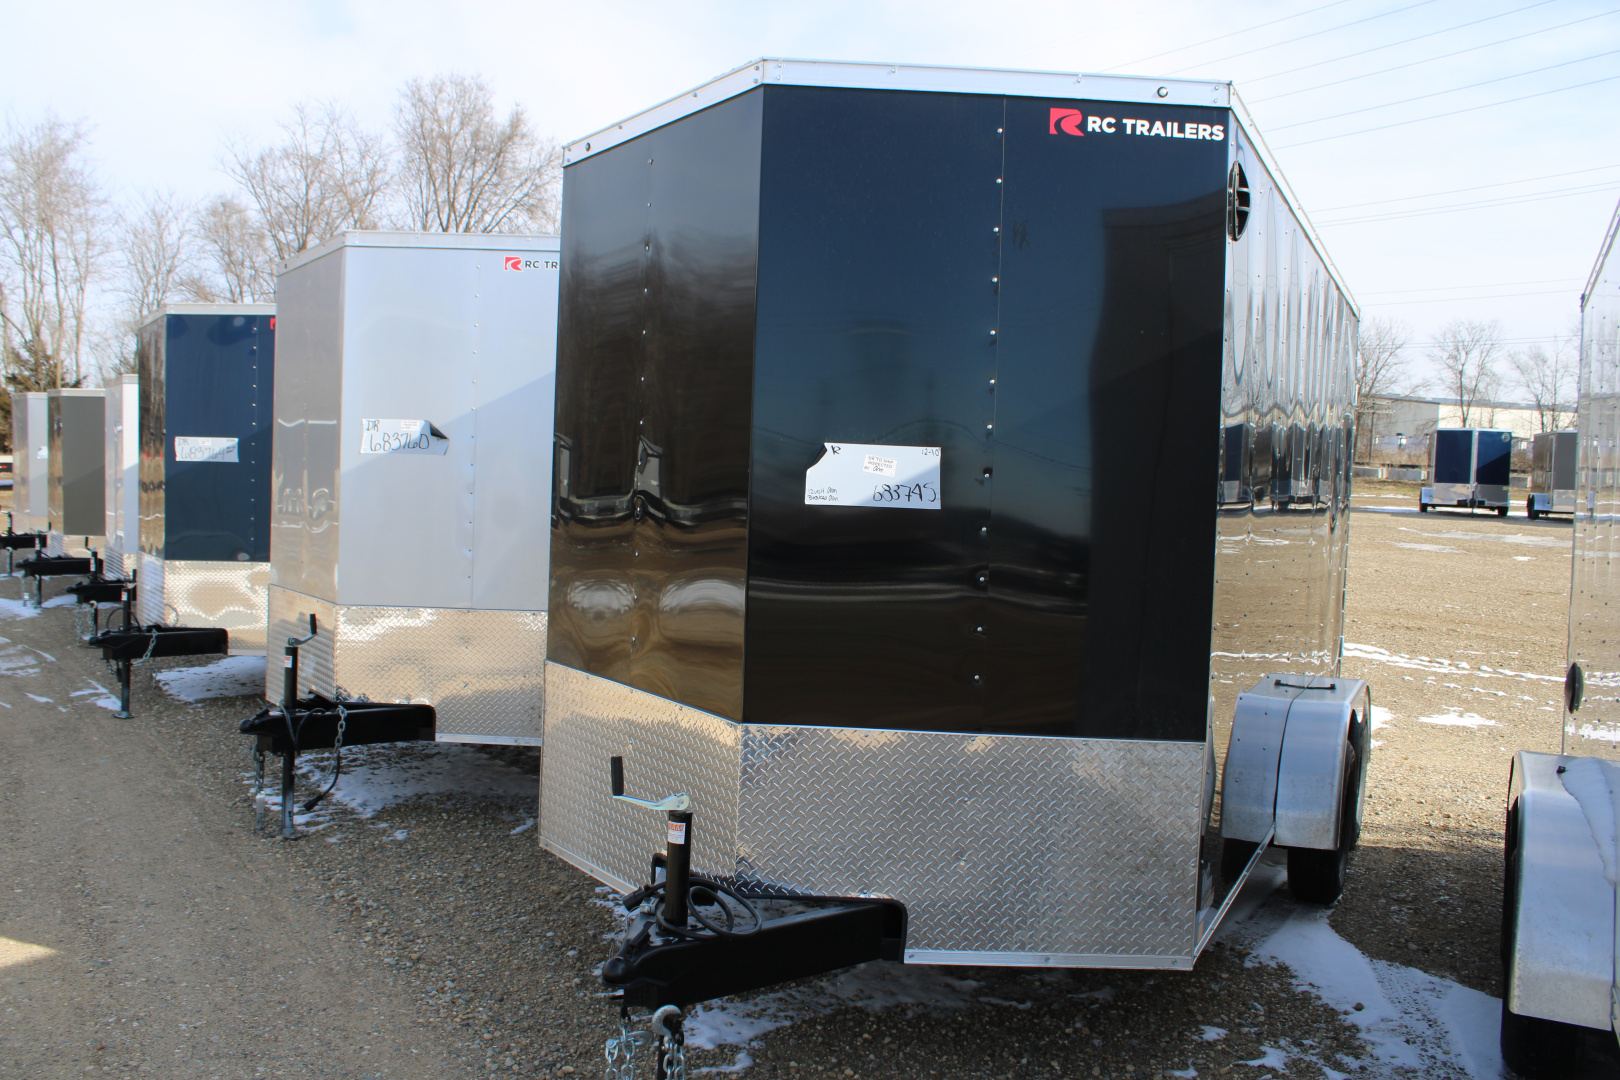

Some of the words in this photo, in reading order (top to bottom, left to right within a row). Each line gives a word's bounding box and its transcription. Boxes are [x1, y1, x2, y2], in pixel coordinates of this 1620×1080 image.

[1087, 115, 1117, 134] RC
[1122, 118, 1225, 141] TRAILERS
[524, 260, 540, 269] RC
[544, 260, 559, 270] TR
